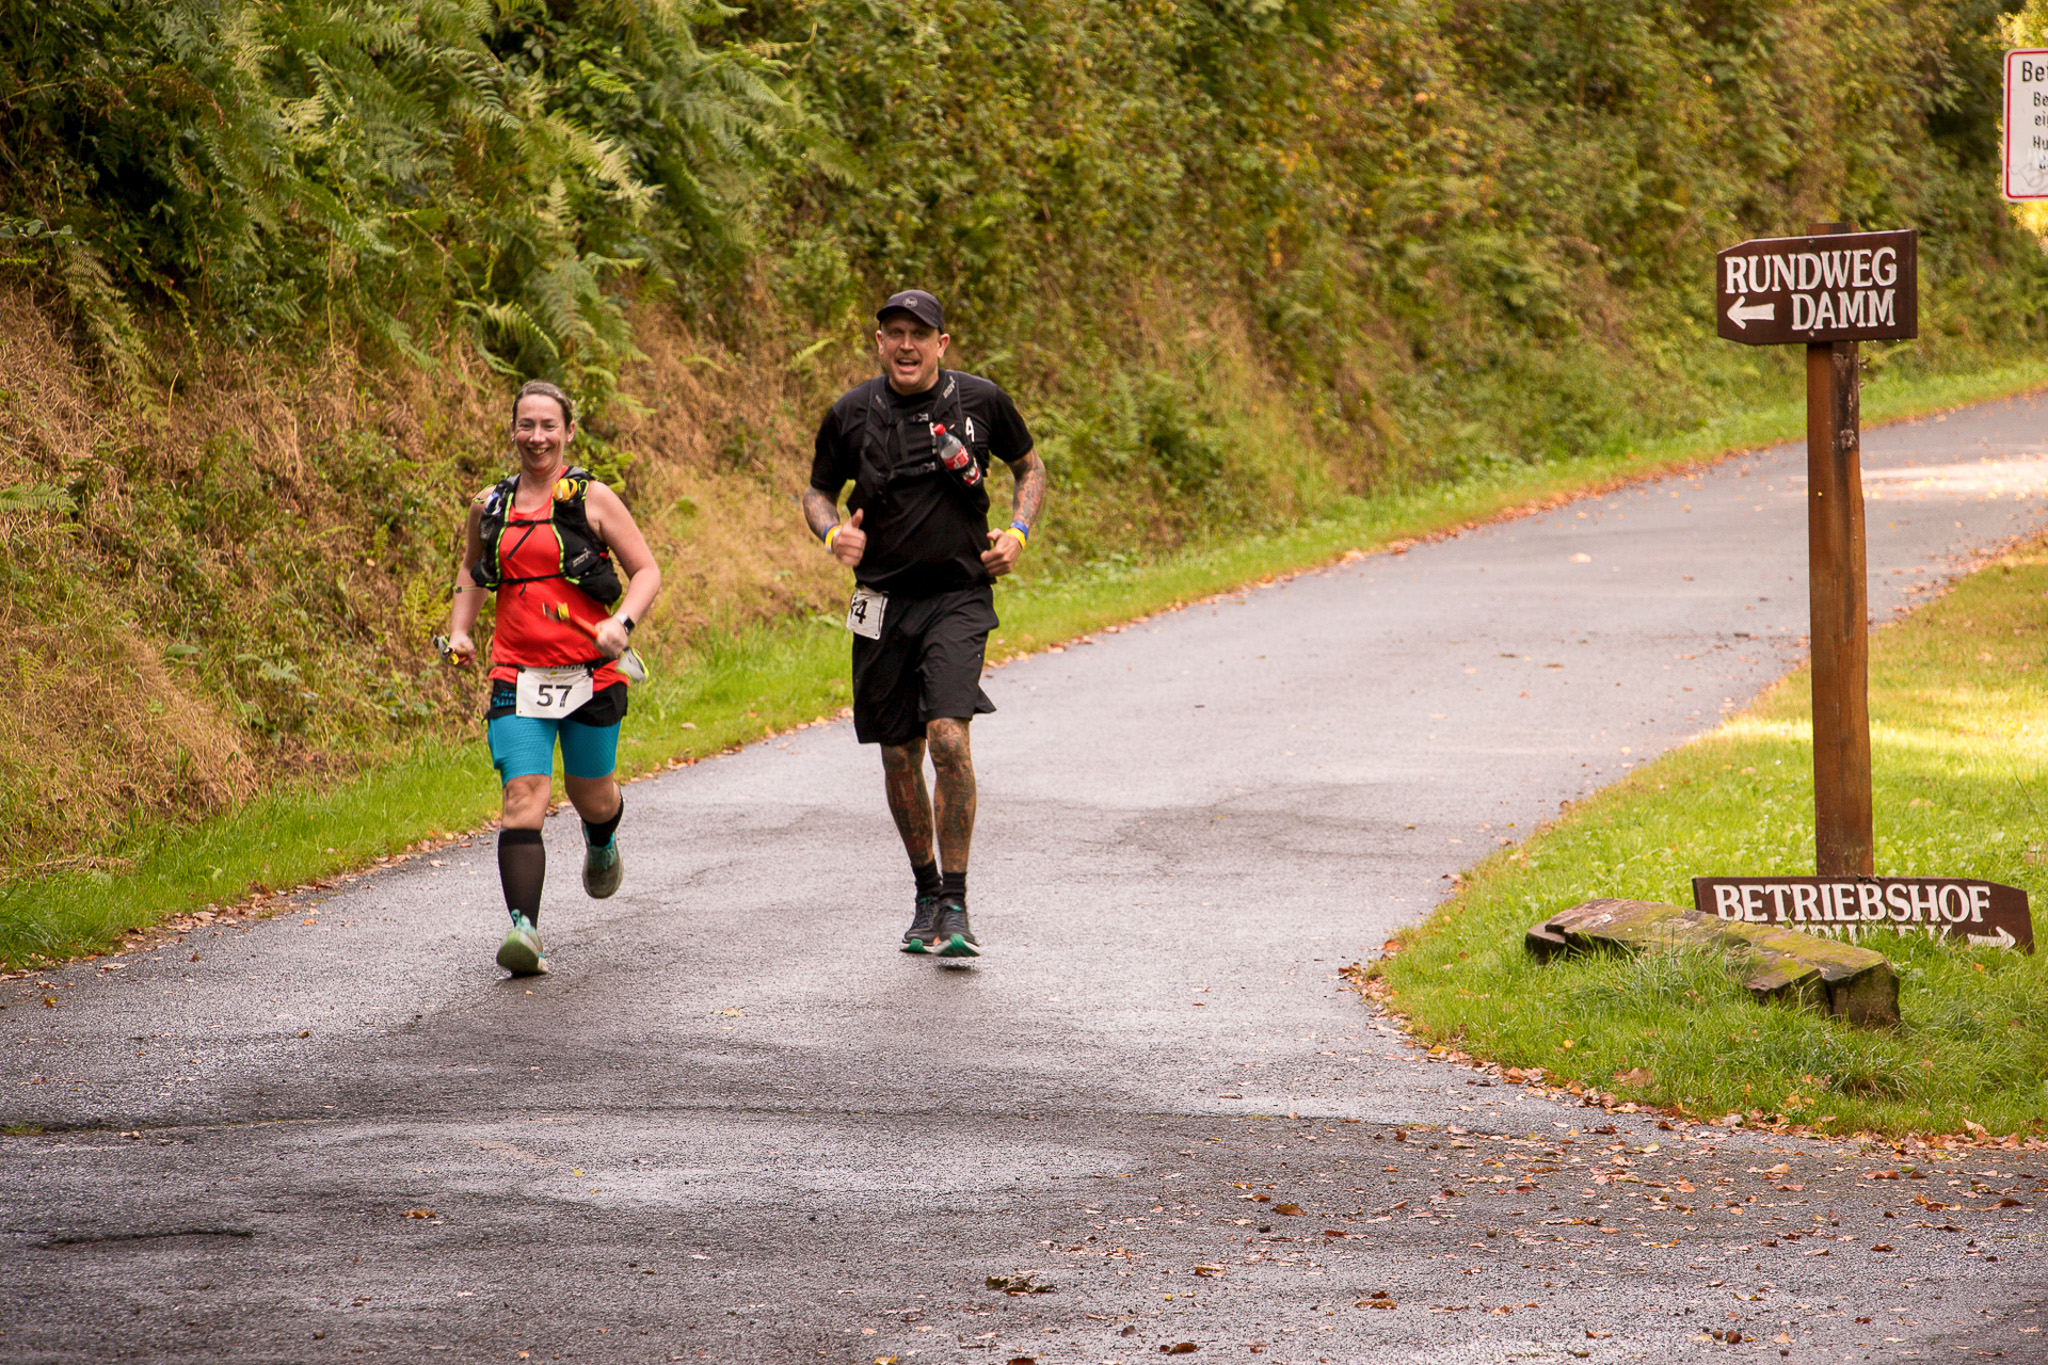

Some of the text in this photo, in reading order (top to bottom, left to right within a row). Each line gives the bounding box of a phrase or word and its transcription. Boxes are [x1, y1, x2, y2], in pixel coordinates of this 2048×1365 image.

[2022, 60, 2048, 82] Be
[1724, 247, 1897, 294] RUNDWEG
[1791, 289, 1896, 330] DAMM
[536, 684, 573, 708] 57
[1713, 883, 1991, 923] BETRIEBSHOF
